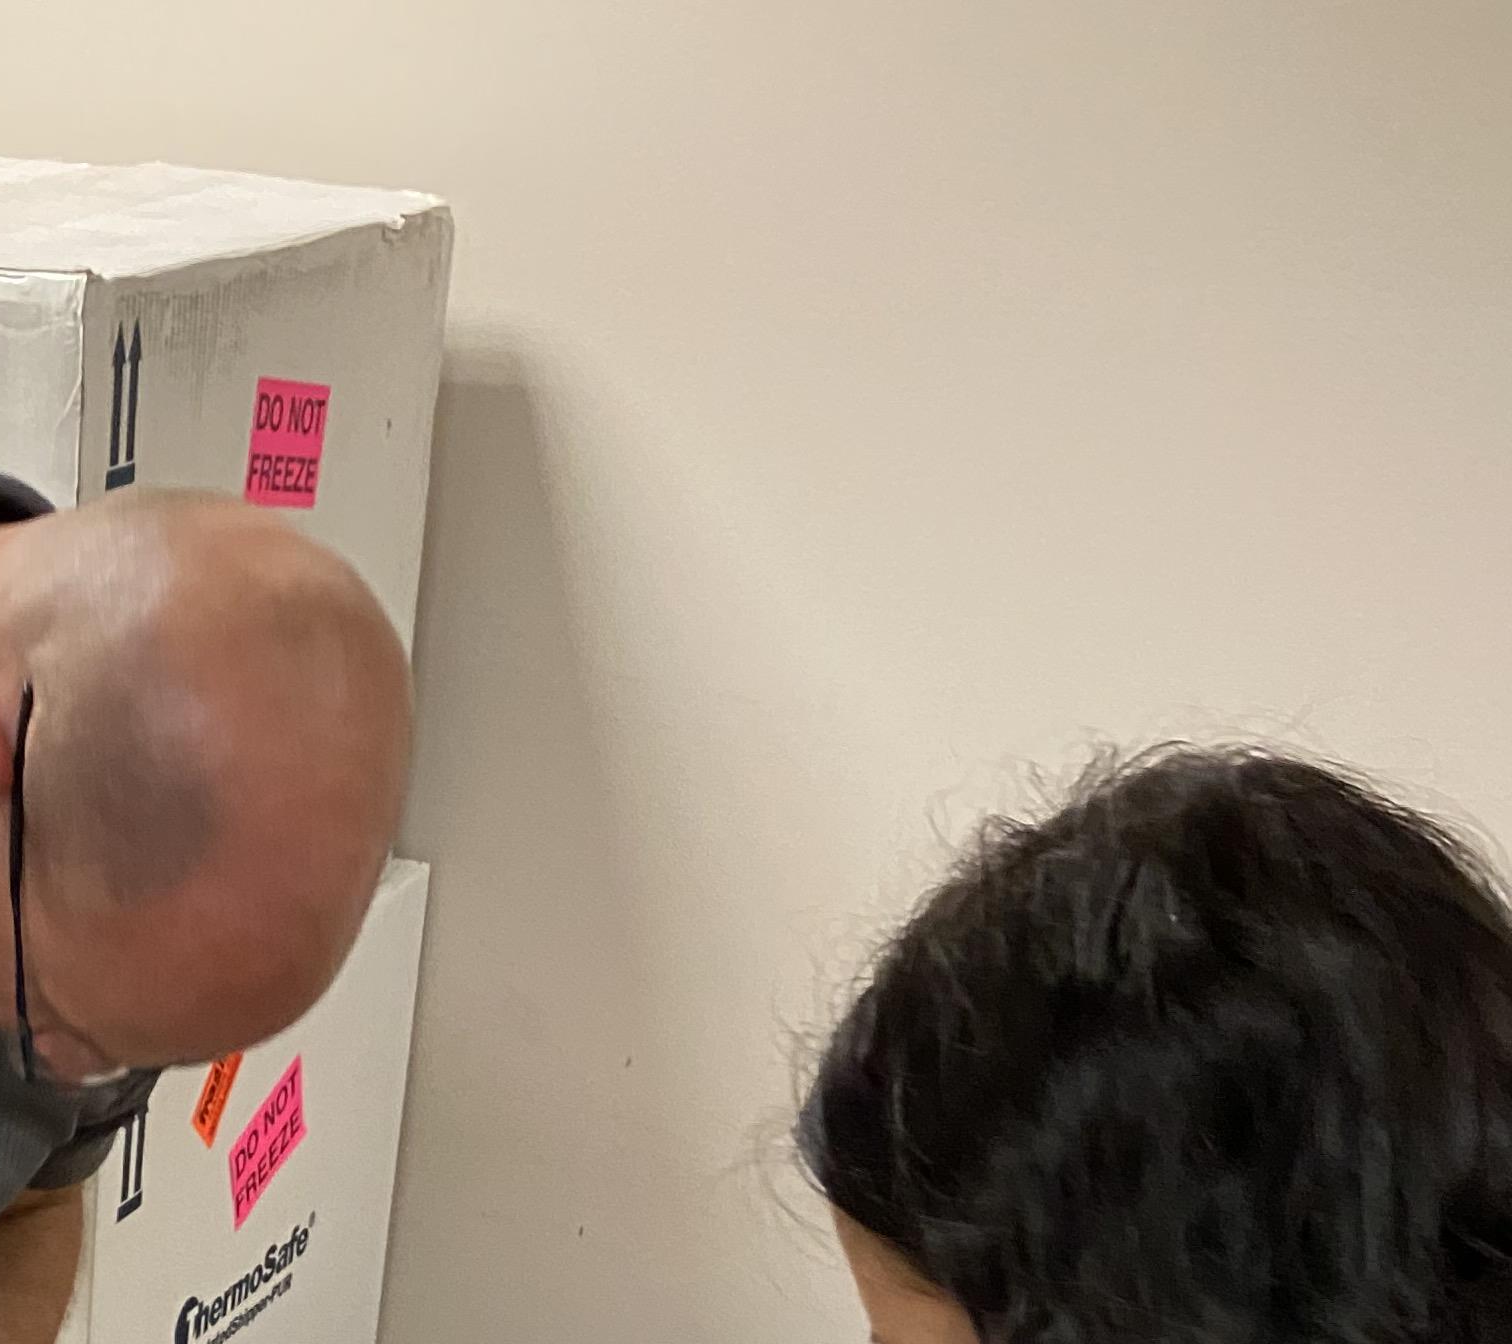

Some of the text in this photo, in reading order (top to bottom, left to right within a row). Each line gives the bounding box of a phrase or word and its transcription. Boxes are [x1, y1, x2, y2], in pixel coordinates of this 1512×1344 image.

[256, 393, 326, 434] DO NOT
[248, 453, 318, 493] FREEZE
[235, 1067, 298, 1179] DO NOT
[235, 1107, 300, 1219] FREEZE
